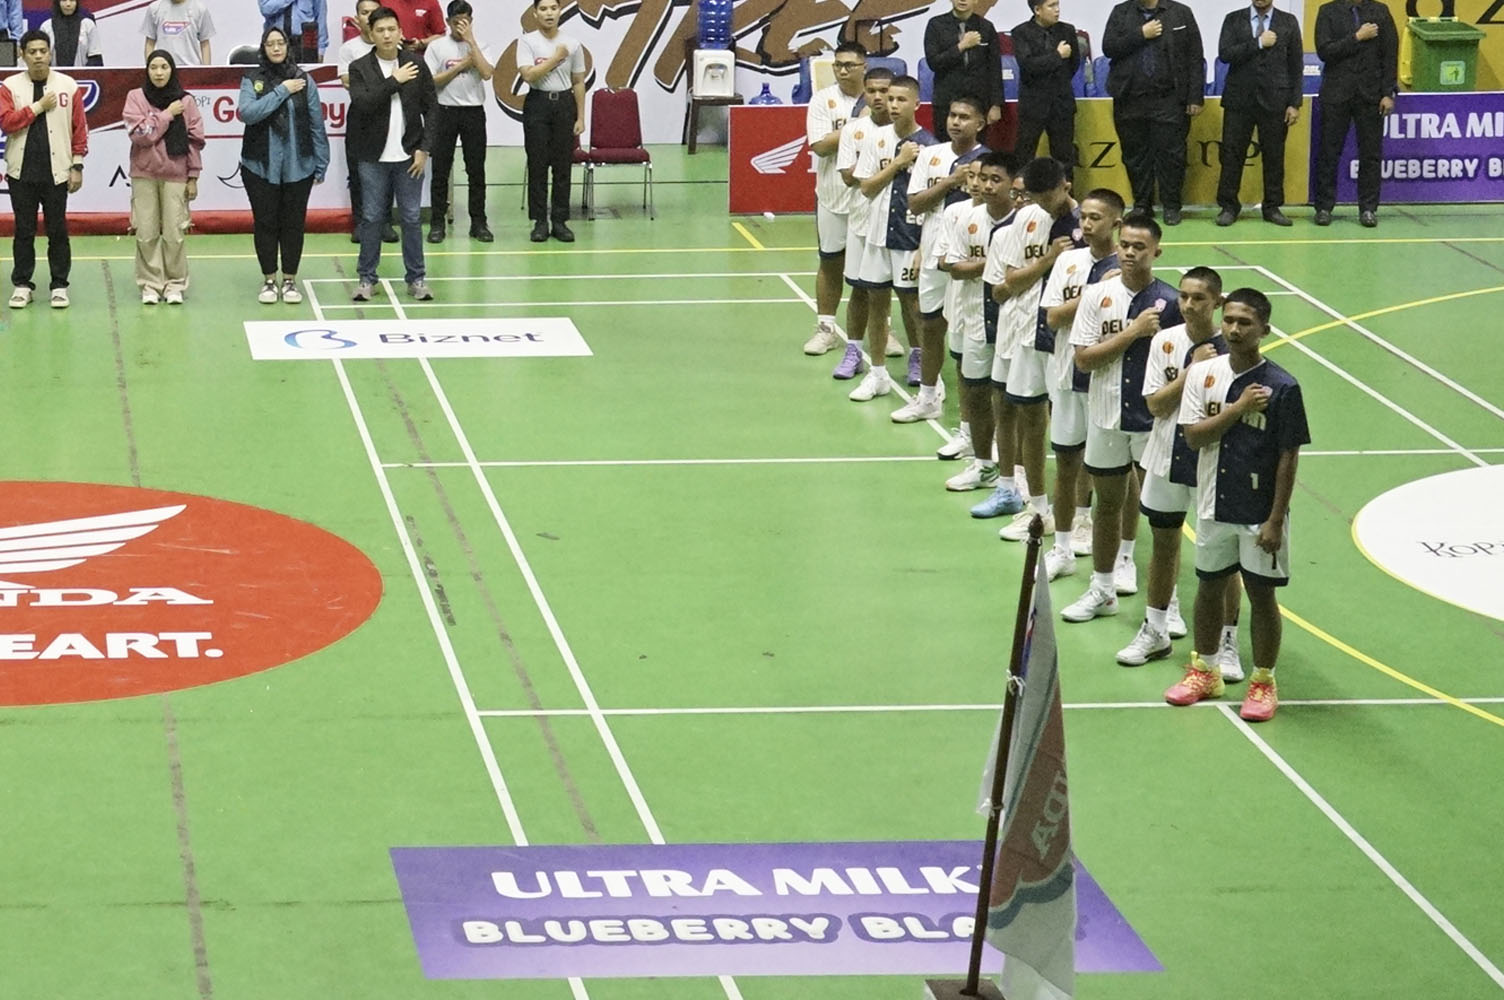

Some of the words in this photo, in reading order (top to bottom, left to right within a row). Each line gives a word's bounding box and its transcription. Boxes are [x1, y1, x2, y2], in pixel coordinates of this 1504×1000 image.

[1349, 157, 1479, 180] BUEBERRY
[378, 331, 544, 345] Biznet
[1249, 472, 1259, 490] 1
[1416, 540, 1504, 558] KOP
[490, 869, 757, 900] ULTRA
[773, 865, 983, 897] MILK
[460, 915, 833, 945] BLUEBERRY
